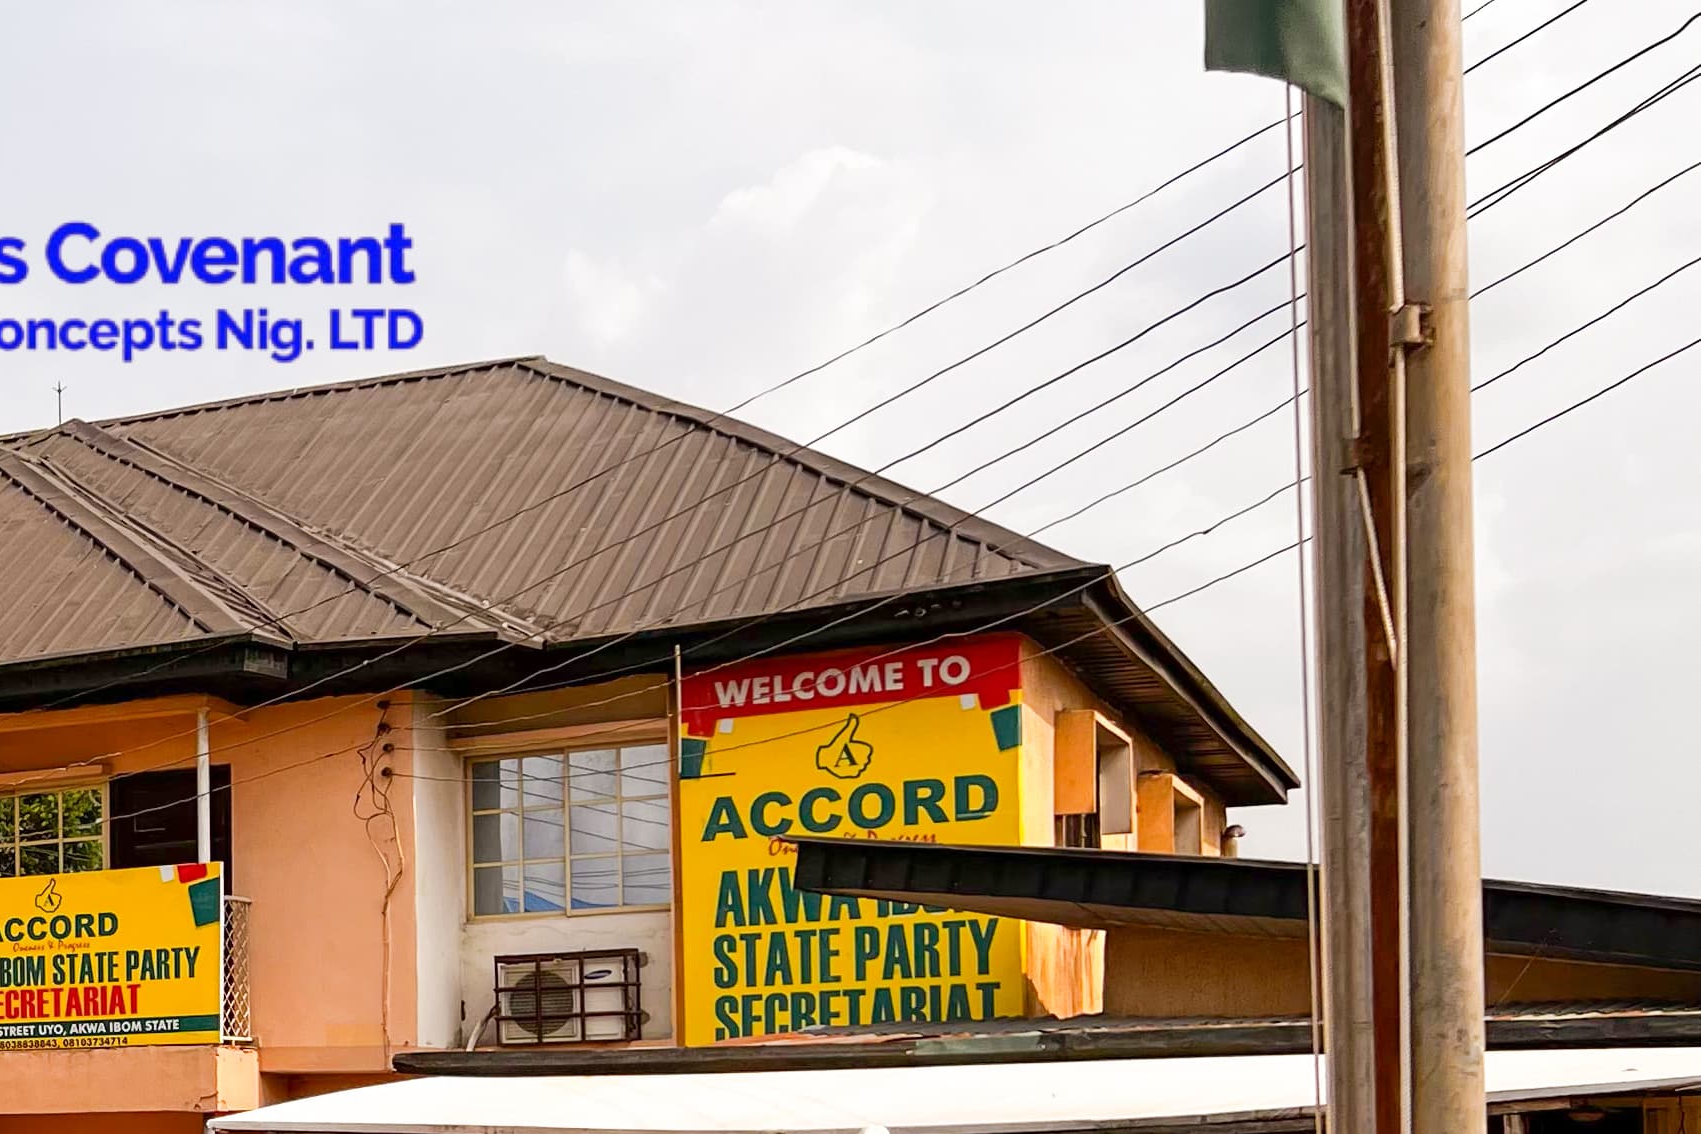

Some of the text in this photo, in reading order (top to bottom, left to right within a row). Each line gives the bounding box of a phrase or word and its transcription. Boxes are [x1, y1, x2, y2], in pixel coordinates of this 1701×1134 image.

[714, 655, 971, 708] WELCOME TO
[834, 743, 858, 768] A
[701, 774, 999, 842] ACCORD
[52, 951, 120, 985] STATE
[126, 946, 201, 982] PARTY
[713, 918, 999, 989] STATE PARTY
[38, 1023, 66, 1036] UYO,
[69, 1022, 106, 1034] AKWA
[109, 1020, 143, 1033] IBOM
[145, 1019, 180, 1032] STATE
[714, 981, 1001, 1041] SECRETARIAT
[62, 1037, 128, 1047] 08103734714
